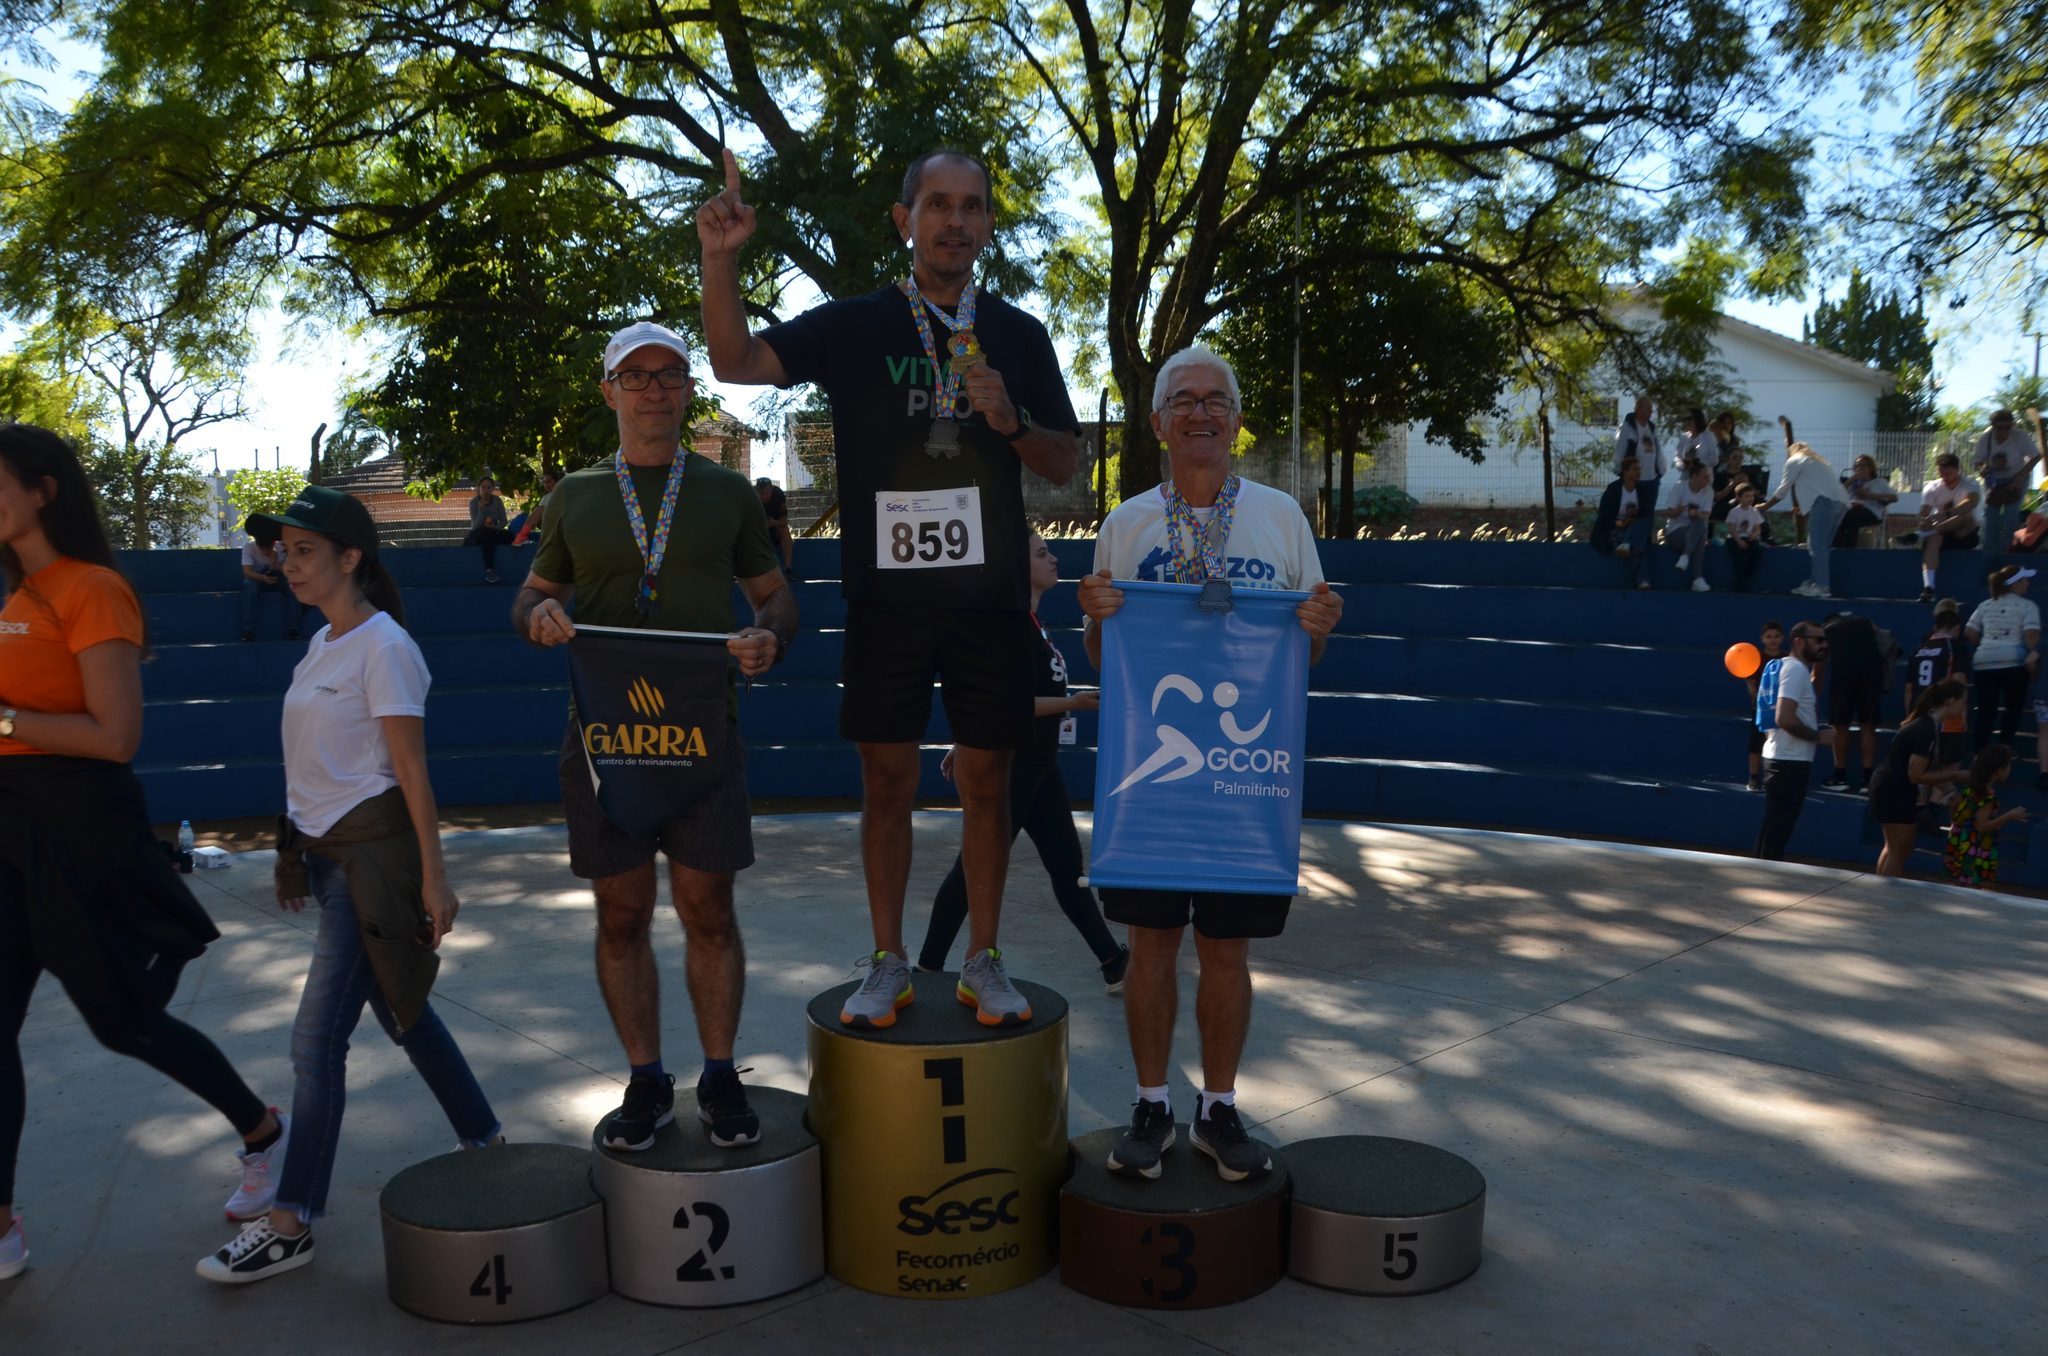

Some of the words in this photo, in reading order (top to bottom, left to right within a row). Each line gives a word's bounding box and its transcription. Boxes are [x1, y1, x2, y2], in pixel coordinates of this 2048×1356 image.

[886, 502, 909, 512] Sesc
[891, 519, 969, 563] 859
[1918, 659, 1934, 687] 9
[584, 722, 708, 757] GARRA
[596, 758, 624, 767] centro
[625, 757, 638, 766] de
[638, 757, 693, 768] treinamento
[1206, 747, 1291, 775] GCOR
[1214, 780, 1290, 798] Palmitinho
[923, 1057, 967, 1164] 1
[896, 1188, 1020, 1236] Sesc
[672, 1201, 736, 1282] 2
[896, 1242, 1020, 1269] Fecomércio
[1382, 1231, 1419, 1281] 5
[1141, 1221, 1197, 1302] 3
[469, 1254, 513, 1305] 4
[898, 1275, 968, 1292] Senac
